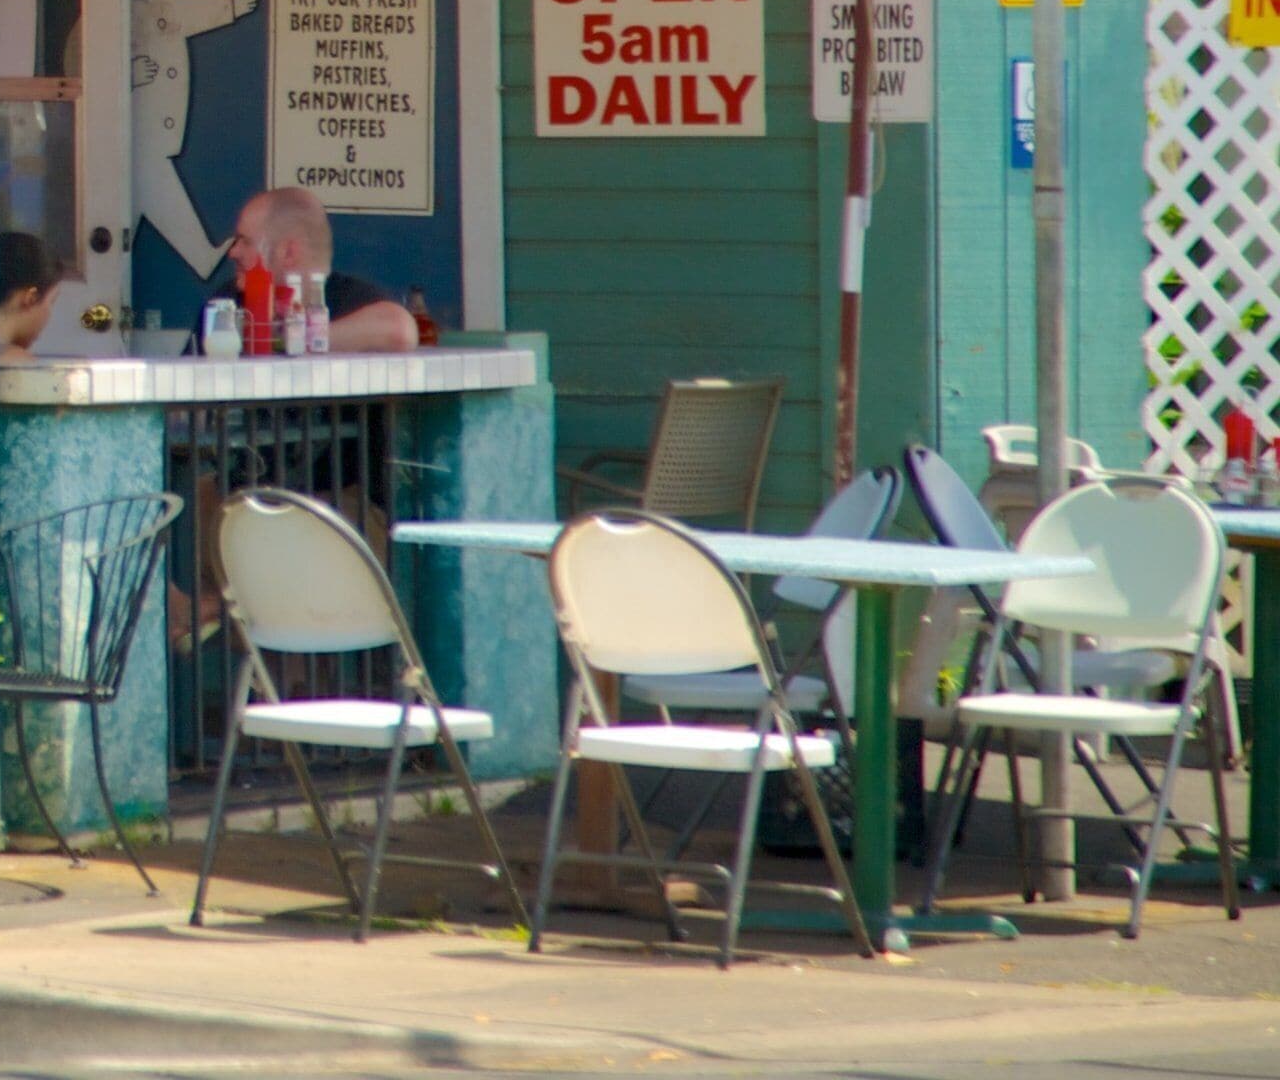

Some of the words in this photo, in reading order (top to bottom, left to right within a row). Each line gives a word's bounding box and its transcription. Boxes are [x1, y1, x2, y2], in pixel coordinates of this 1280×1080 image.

[290, 13, 343, 33] BAKED
[351, 14, 415, 34] BREADS
[831, 3, 914, 30] SMKING
[315, 39, 389, 62] MUFFINS,
[580, 14, 709, 64] 5am
[821, 38, 924, 63] PROBITED
[312, 65, 391, 88] PASTRIES,
[288, 91, 416, 116] SANDWICHES,
[547, 74, 757, 126] DAILY
[318, 118, 386, 139] COFFEES
[345, 144, 357, 163] &
[297, 166, 405, 189] CAPPUCCINOS
